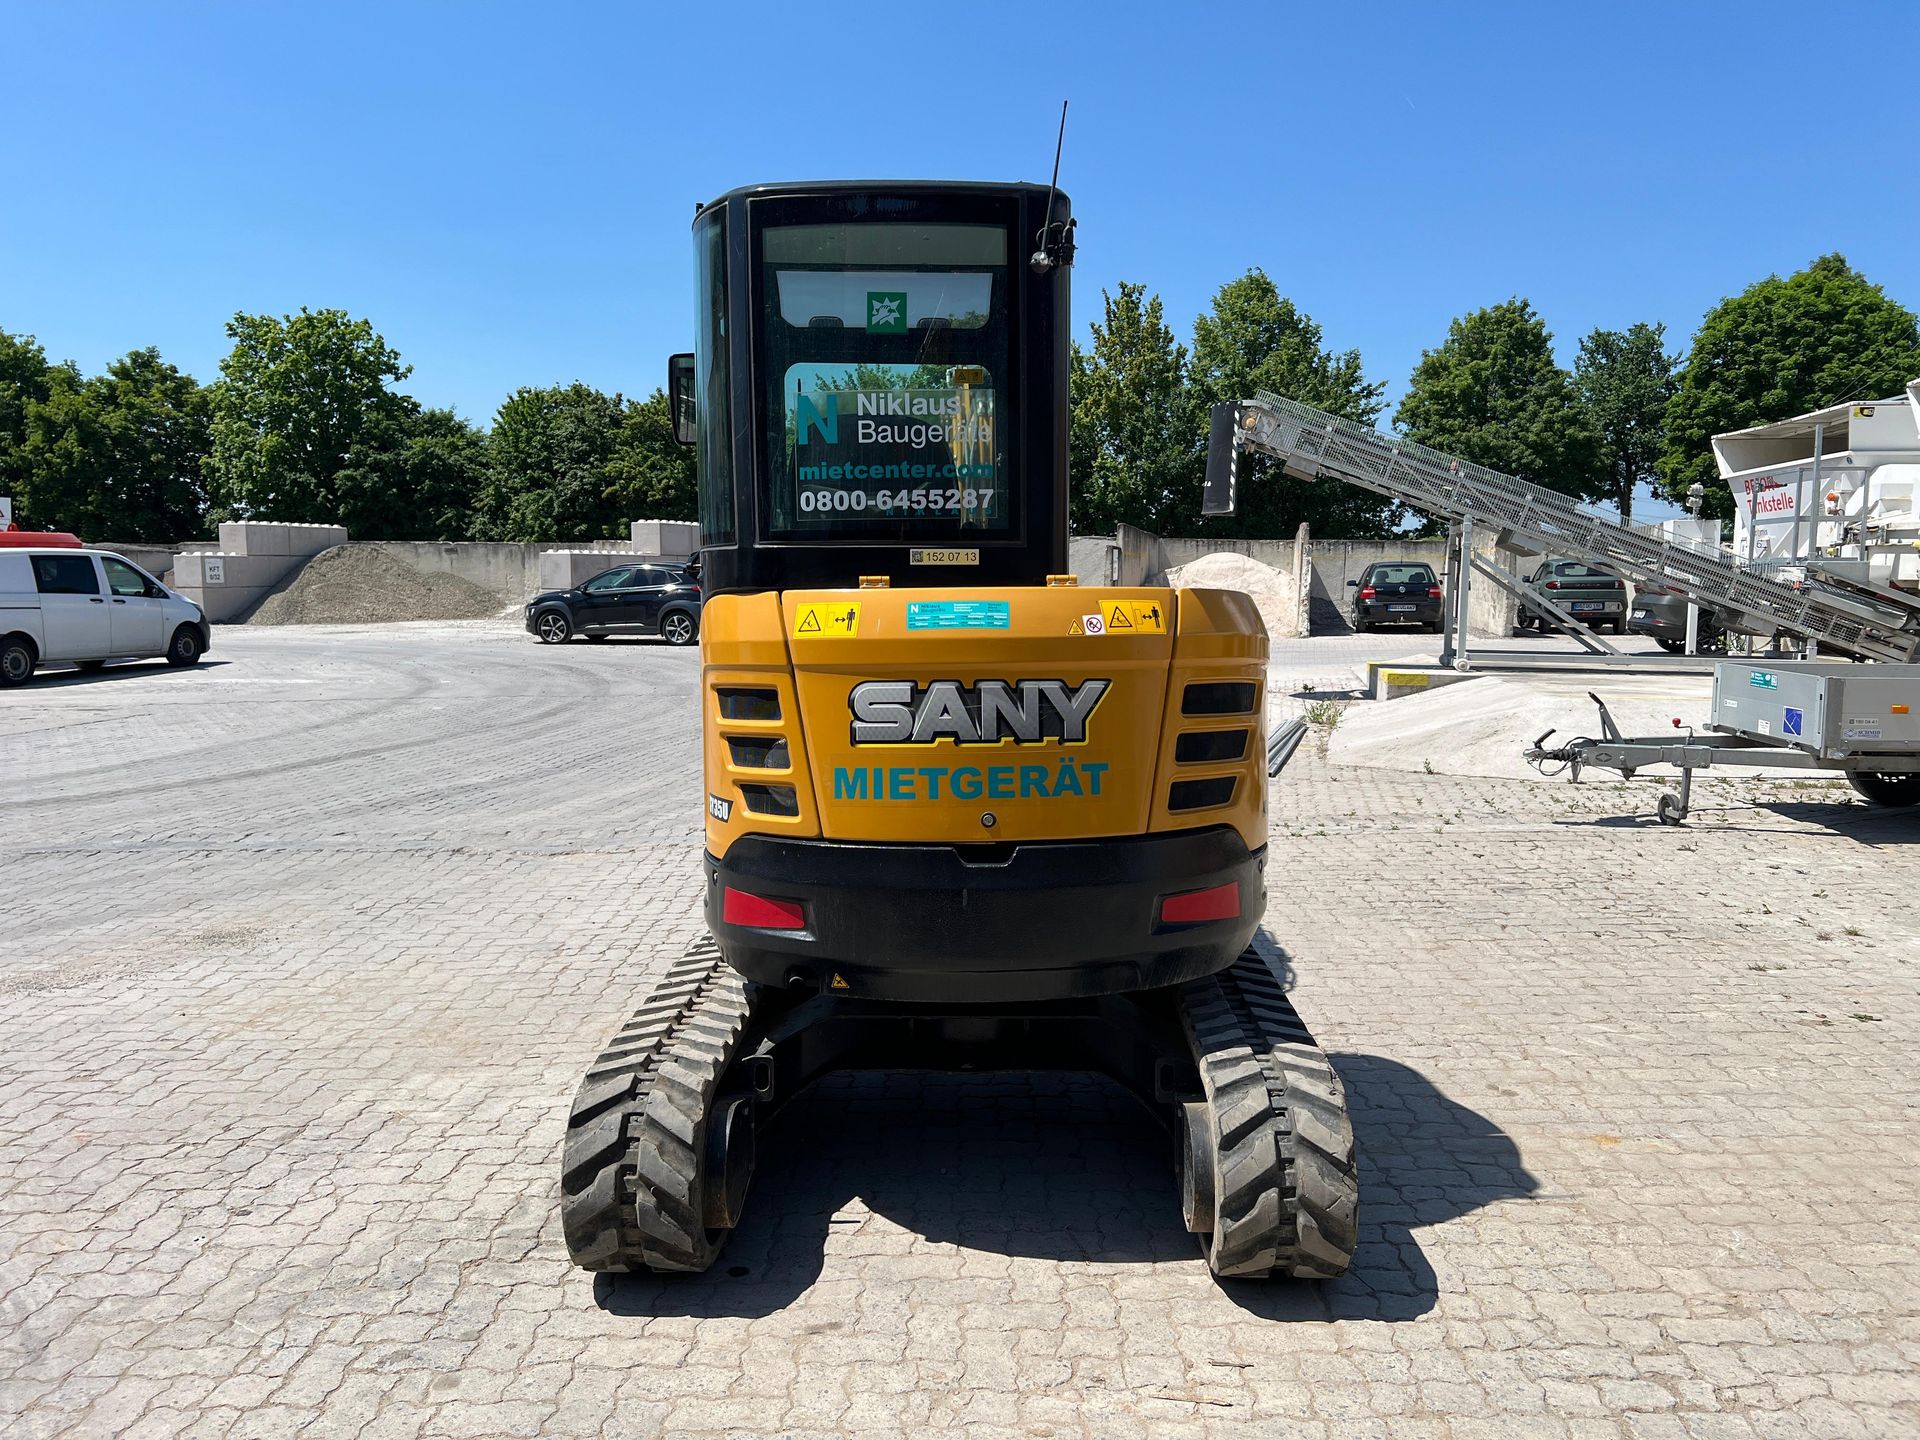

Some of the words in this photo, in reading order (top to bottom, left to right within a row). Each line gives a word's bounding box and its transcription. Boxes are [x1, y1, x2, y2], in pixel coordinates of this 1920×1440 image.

[857, 393, 961, 415] Niklaus
[798, 395, 838, 445] N
[858, 420, 992, 449] Baugeräte
[800, 462, 993, 481] mietcenter.com
[800, 489, 994, 512] 0800-6455287
[1747, 493, 1794, 514] Tnkstelle
[926, 552, 945, 562] 152
[948, 552, 961, 562] 07
[964, 552, 977, 562] 13
[910, 603, 919, 614] N
[849, 680, 1111, 744] SANY
[834, 757, 1109, 801] MIETGERÄT
